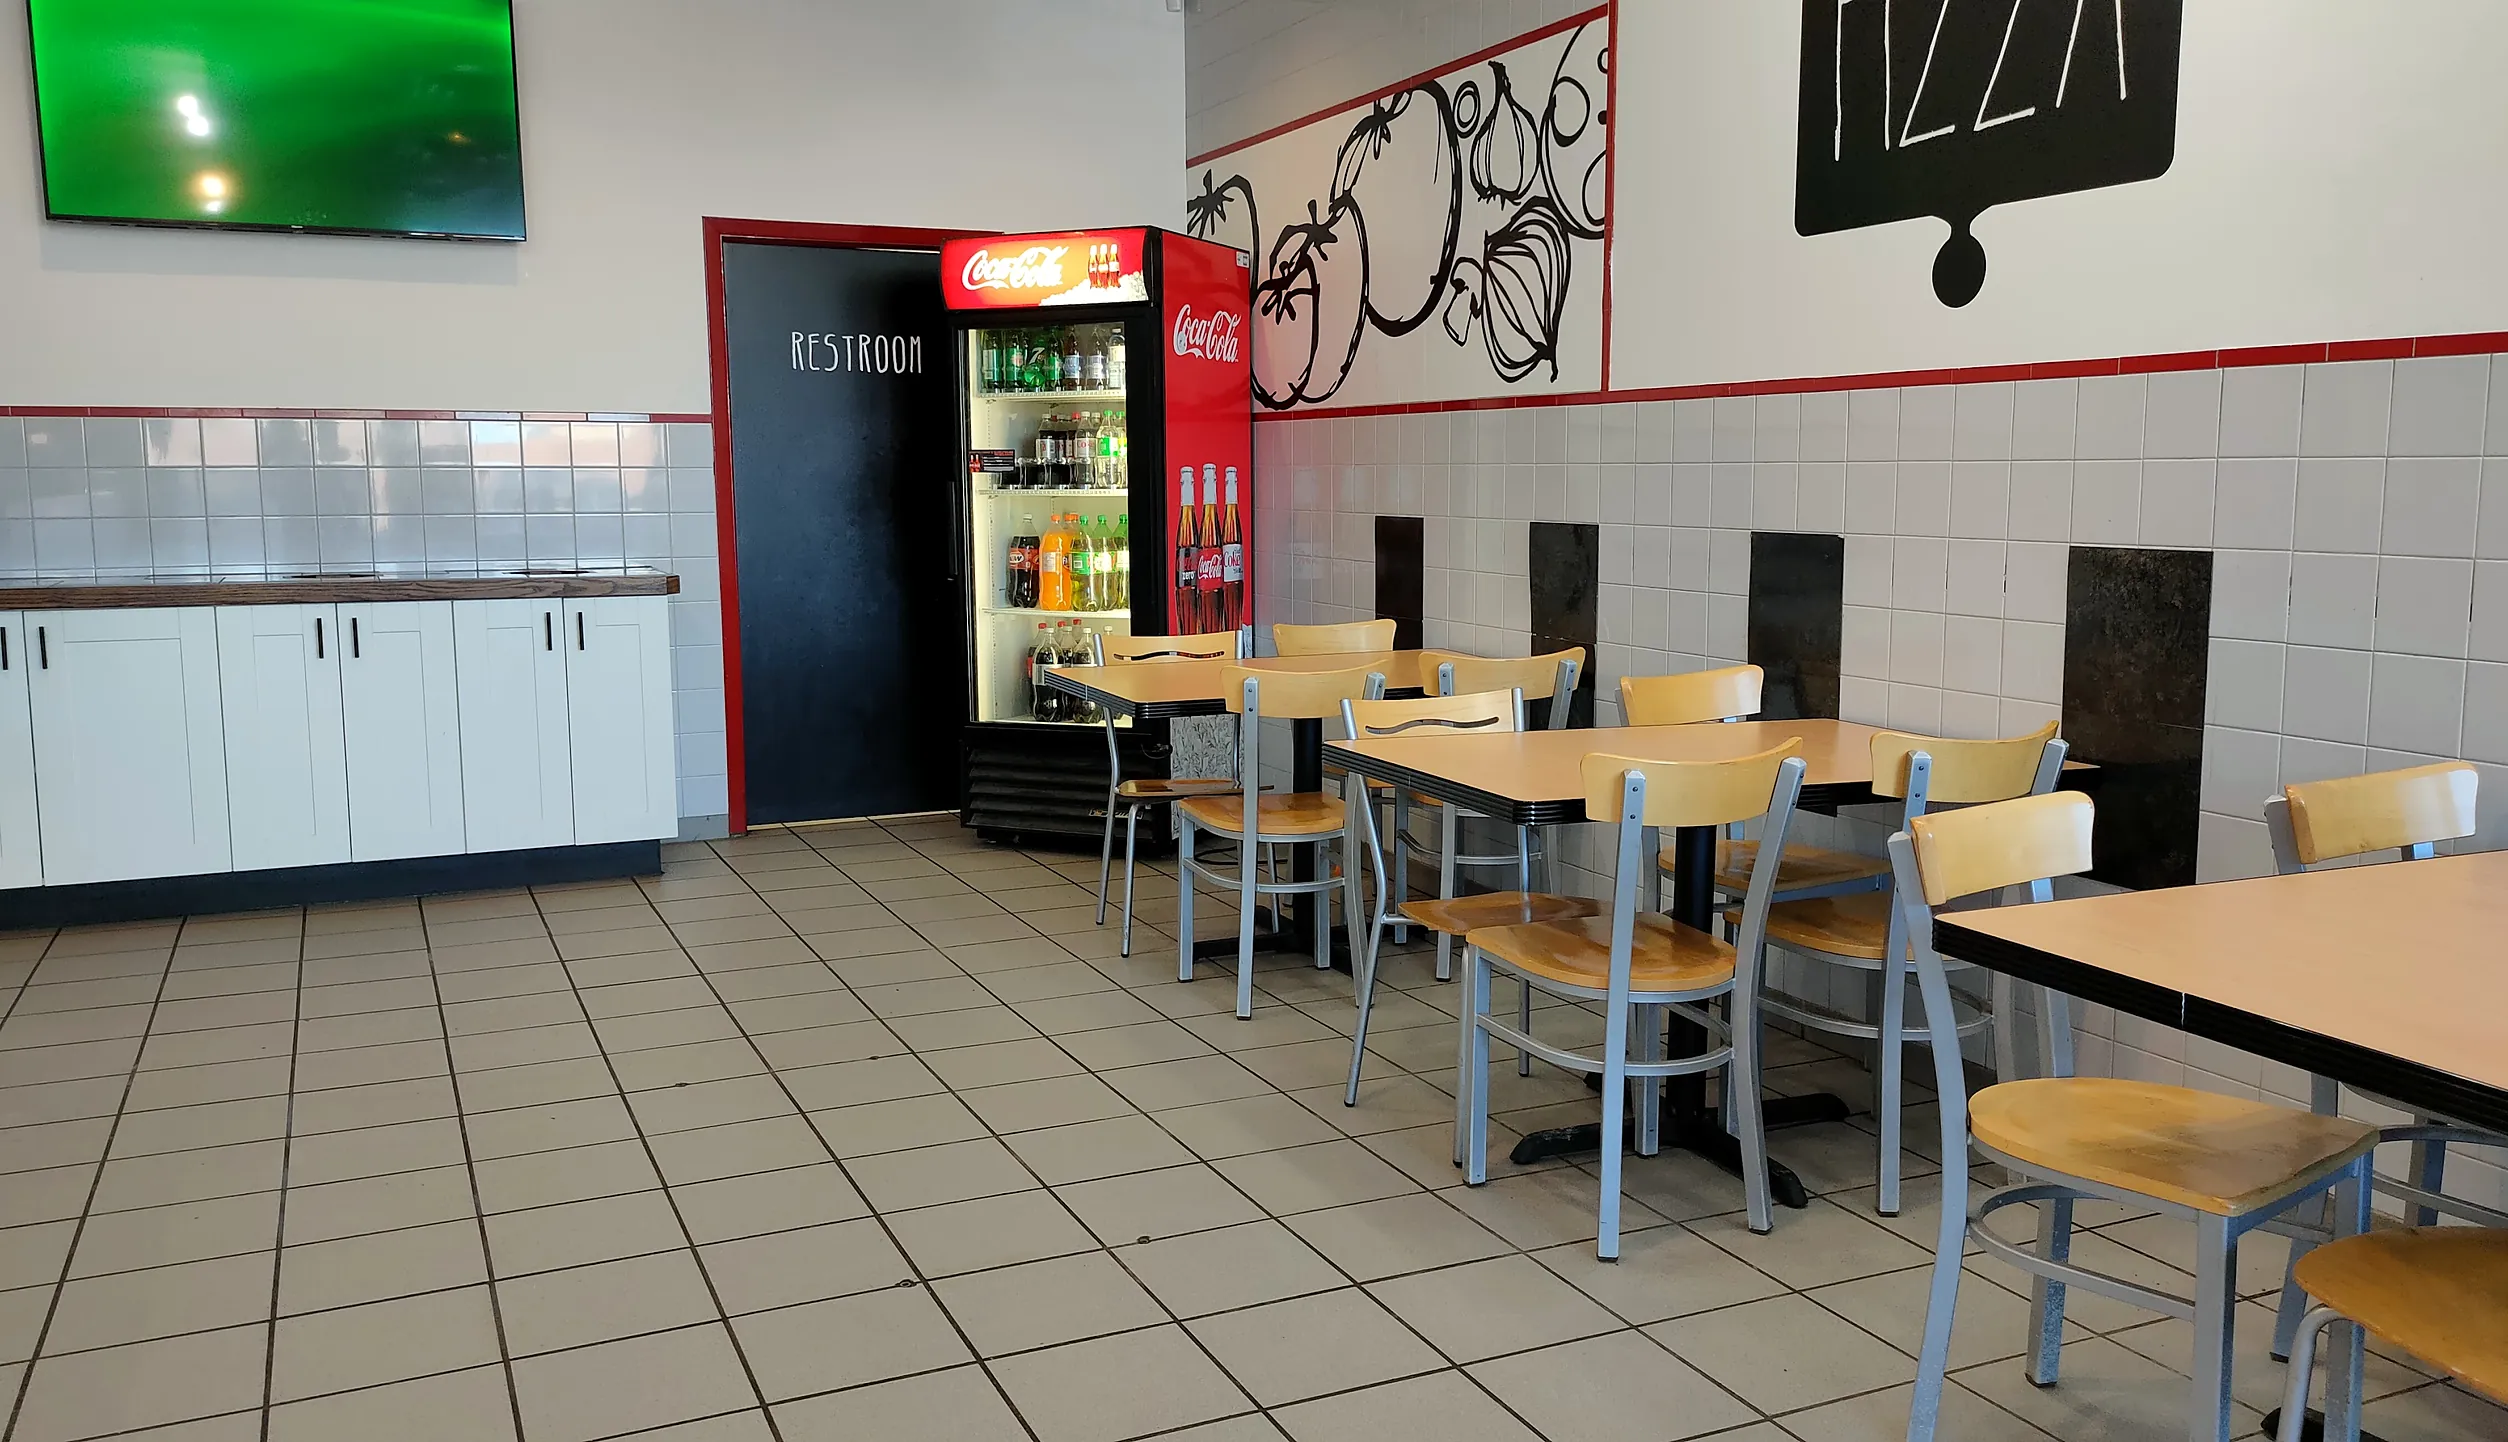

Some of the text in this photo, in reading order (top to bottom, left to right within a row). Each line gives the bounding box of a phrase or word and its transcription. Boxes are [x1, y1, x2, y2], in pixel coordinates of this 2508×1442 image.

[962, 246, 1070, 291] Coca-Cola
[791, 331, 922, 374] RESTROOM
[1173, 304, 1241, 363] Coca-Cola
[1182, 571, 1196, 580] zero
[1198, 554, 1223, 579] Coca-Cola
